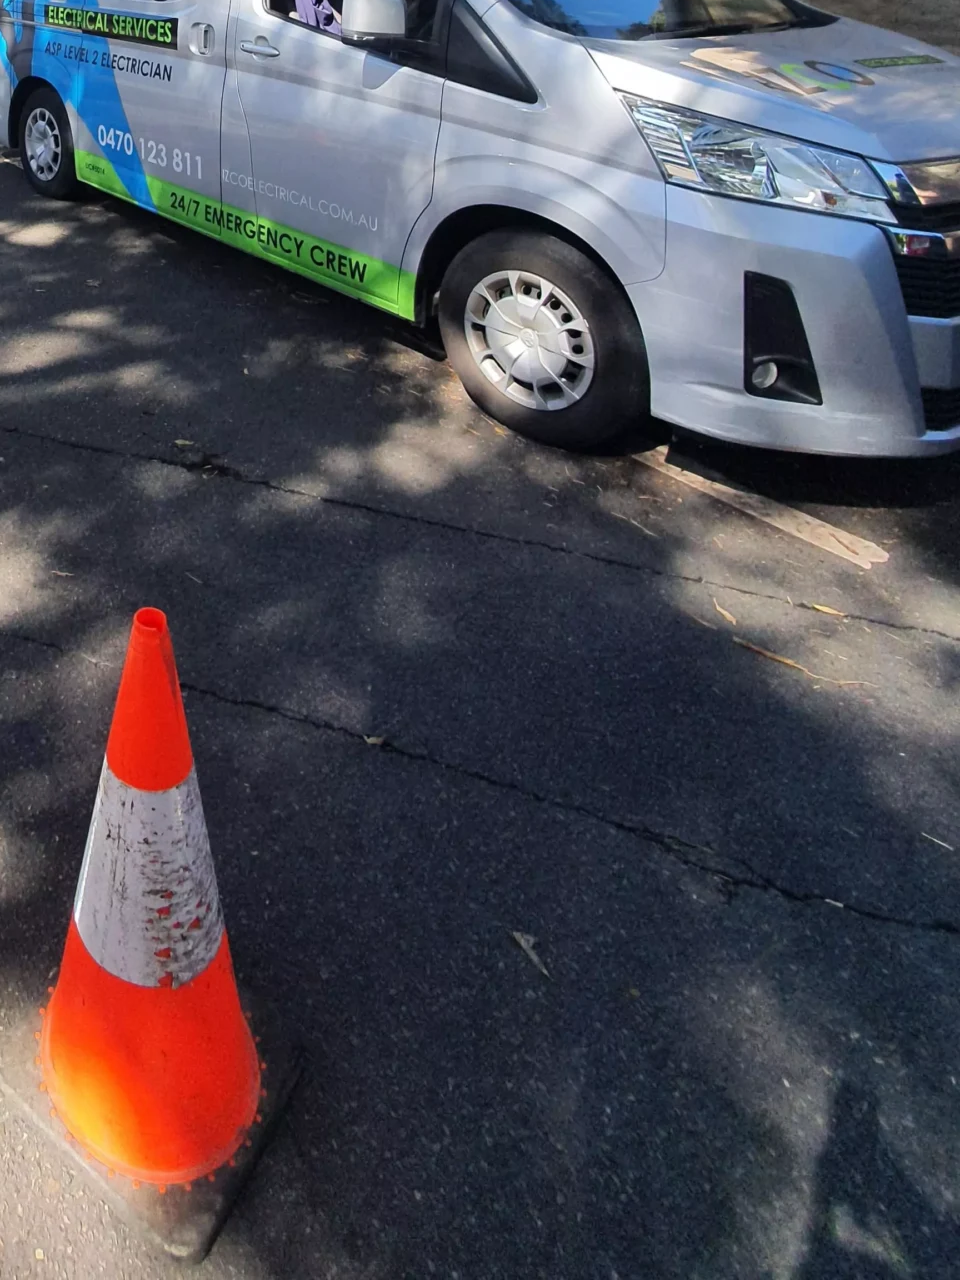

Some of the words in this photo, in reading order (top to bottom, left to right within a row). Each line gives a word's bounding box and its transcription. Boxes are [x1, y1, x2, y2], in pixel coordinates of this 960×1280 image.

[48, 5, 109, 33] ELECTRICAL
[112, 14, 172, 44] SERVICES
[44, 40, 62, 57] ASP
[63, 46, 89, 64] LEVEL
[91, 52, 100, 65] 2
[100, 52, 173, 82] ELECTRICIAN
[97, 124, 134, 156] 0470
[139, 137, 168, 167] 123
[172, 148, 202, 180] 811
[221, 168, 378, 231] IZCOELECTRICAL.COM.AU
[170, 192, 200, 217] 24/7
[204, 205, 304, 258] EMERGENCY
[310, 245, 368, 283] CREW
